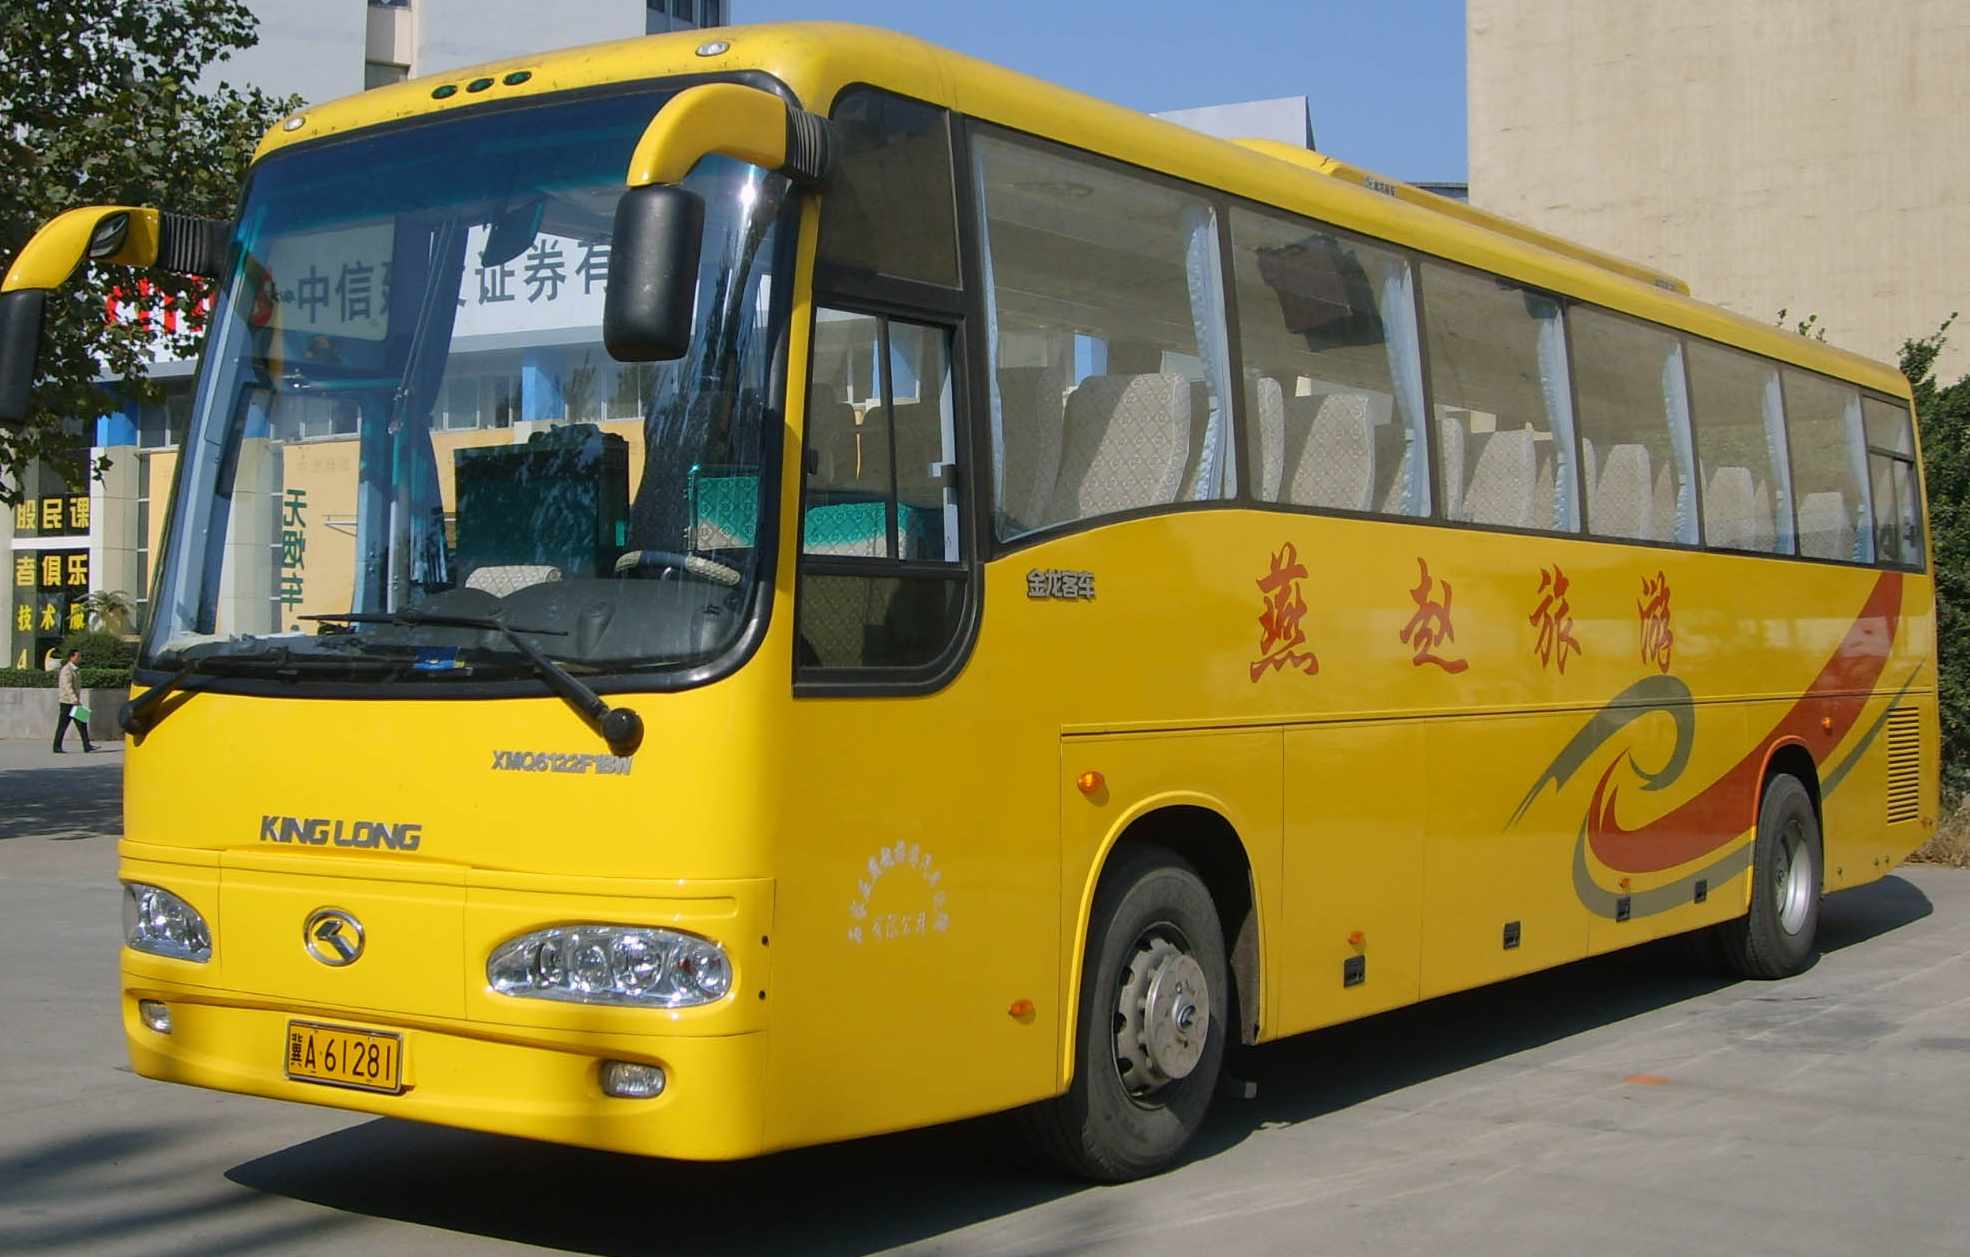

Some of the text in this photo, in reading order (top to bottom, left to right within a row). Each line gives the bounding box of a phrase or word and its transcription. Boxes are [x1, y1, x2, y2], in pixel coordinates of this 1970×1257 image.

[16, 554, 88, 586] 者俱乐
[1027, 568, 1095, 600] 金龙客车
[260, 815, 422, 851] KING LONG
